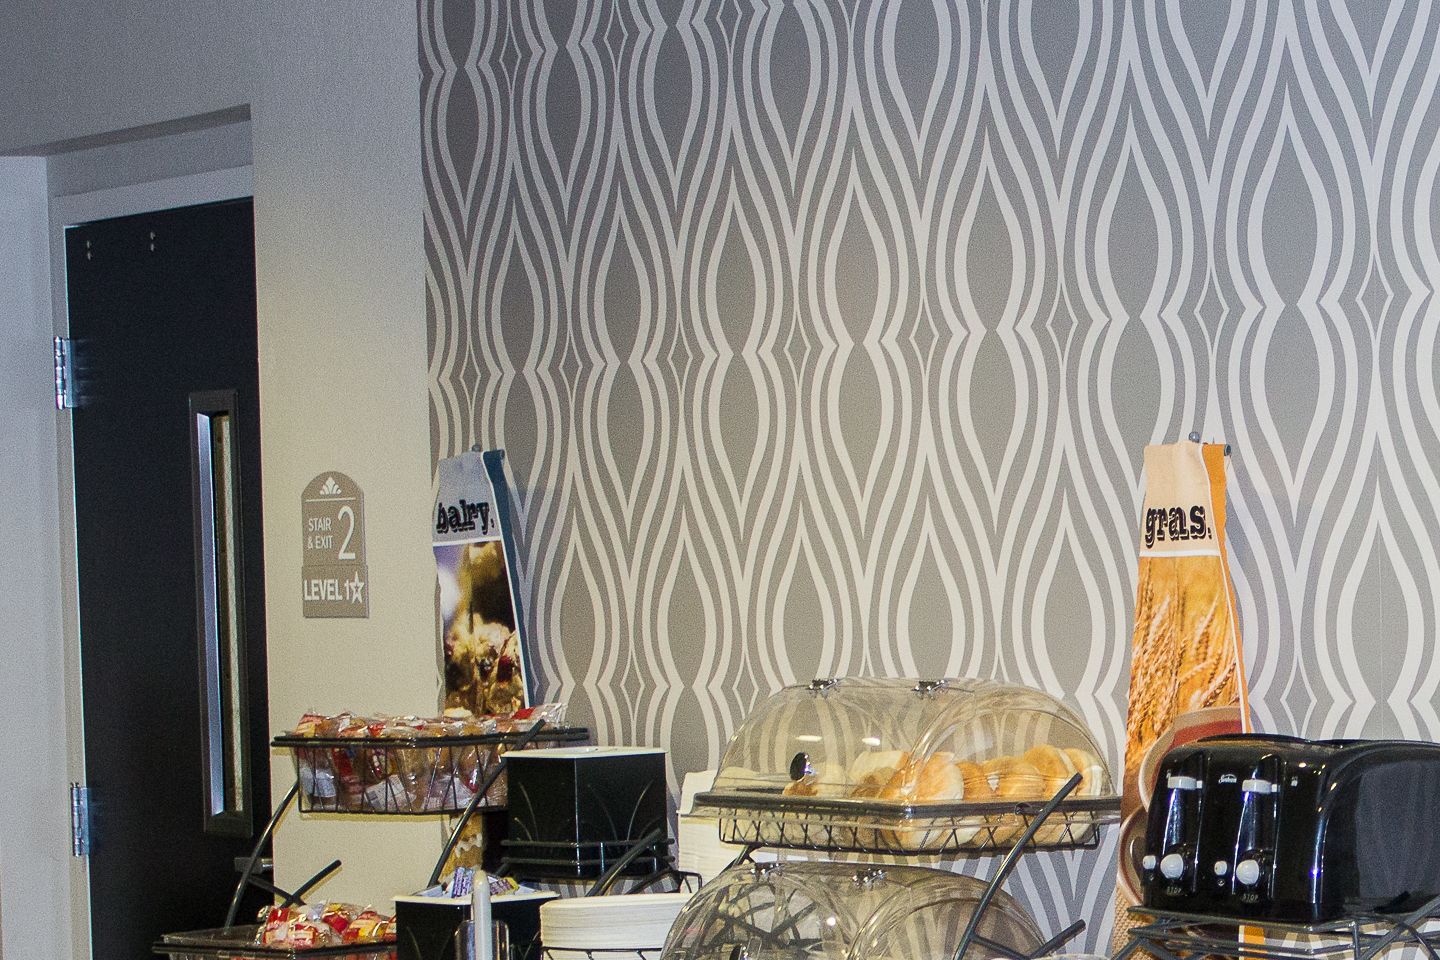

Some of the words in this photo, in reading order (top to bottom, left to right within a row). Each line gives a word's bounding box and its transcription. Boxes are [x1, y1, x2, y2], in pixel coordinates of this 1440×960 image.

[308, 517, 331, 532] STAIR
[338, 506, 356, 560] 2
[307, 535, 313, 549] &
[315, 535, 333, 549] EXIT
[304, 578, 343, 601] LEVEL
[344, 578, 350, 601] 1
